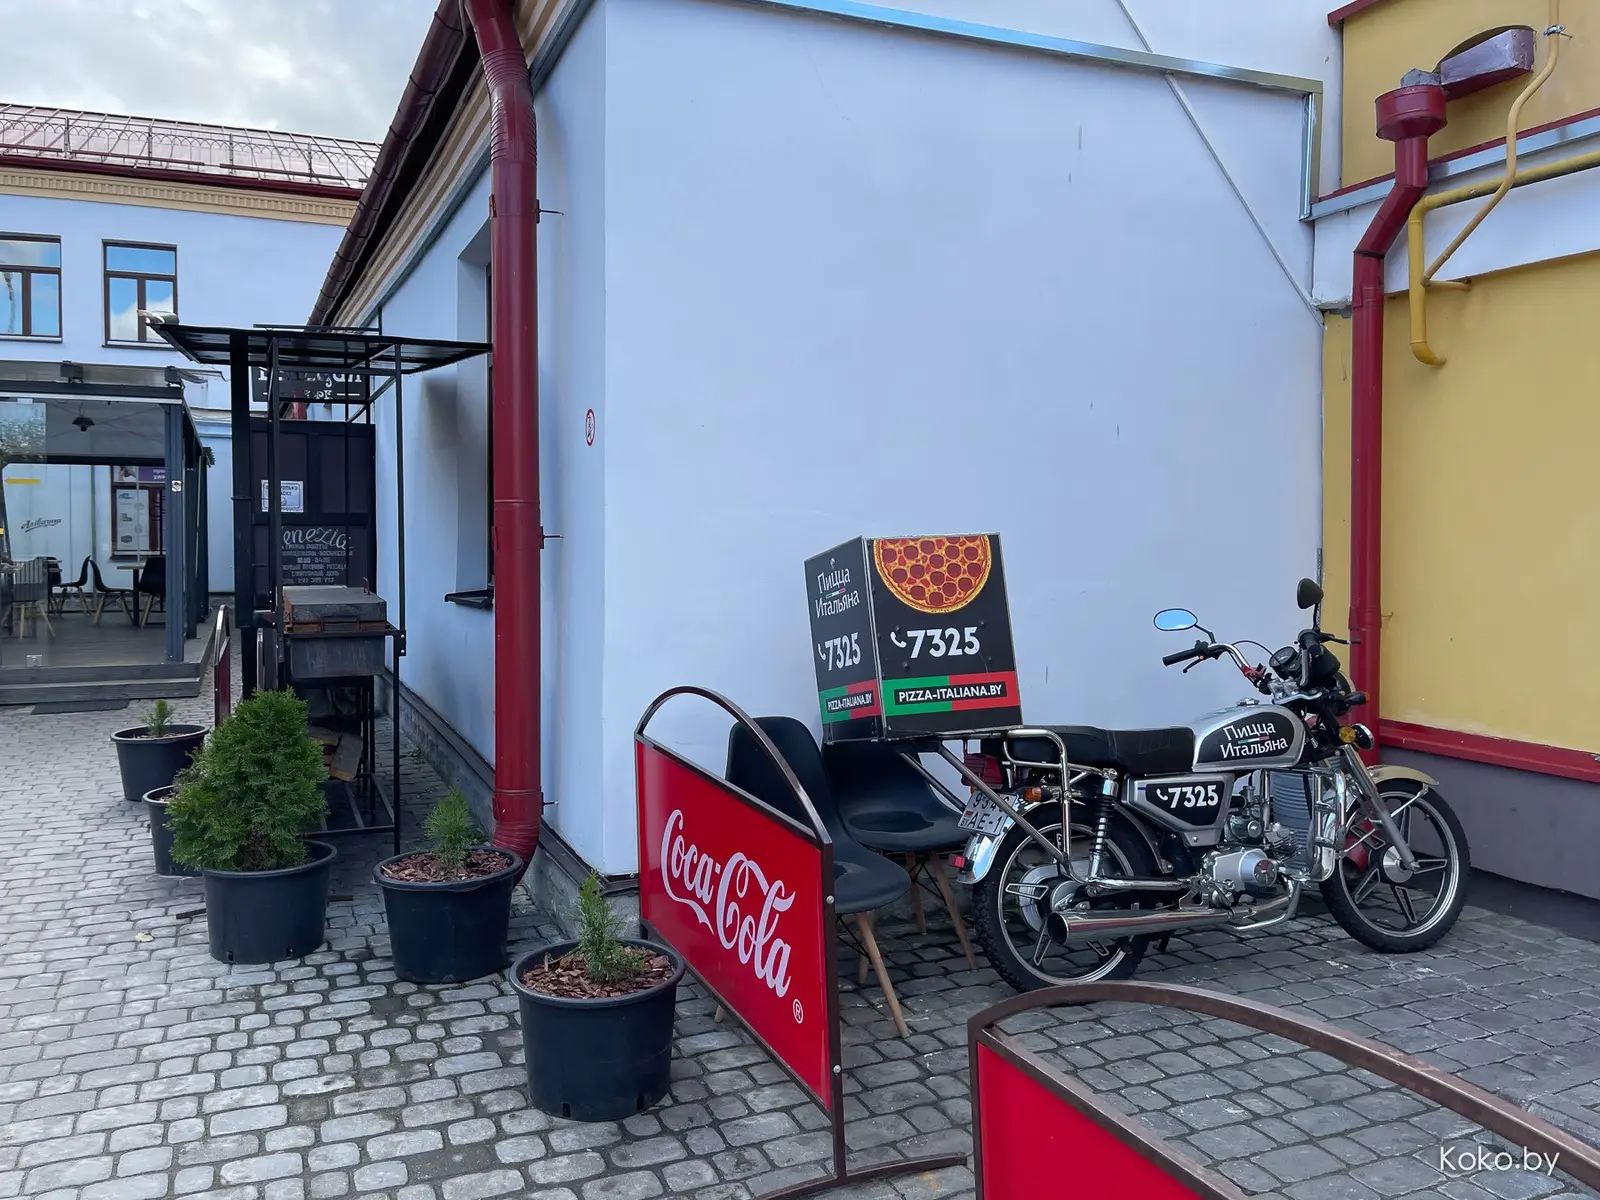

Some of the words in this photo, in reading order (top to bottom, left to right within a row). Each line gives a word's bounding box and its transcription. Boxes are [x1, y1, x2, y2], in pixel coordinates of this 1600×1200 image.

[282, 527, 346, 549] enezia
[817, 568, 851, 595] Пицца
[815, 590, 860, 619] Итальяна
[825, 632, 861, 671] 7325
[906, 626, 981, 659] 7325
[827, 693, 873, 711] PIZZA-ITALIANA.BY
[898, 684, 1003, 703] PIZZA-ITALIANA.BY
[1223, 722, 1276, 741] Пицца
[1220, 737, 1288, 759] Итальяна
[1167, 785, 1219, 809] 7325
[661, 809, 796, 998] Coca-Cola
